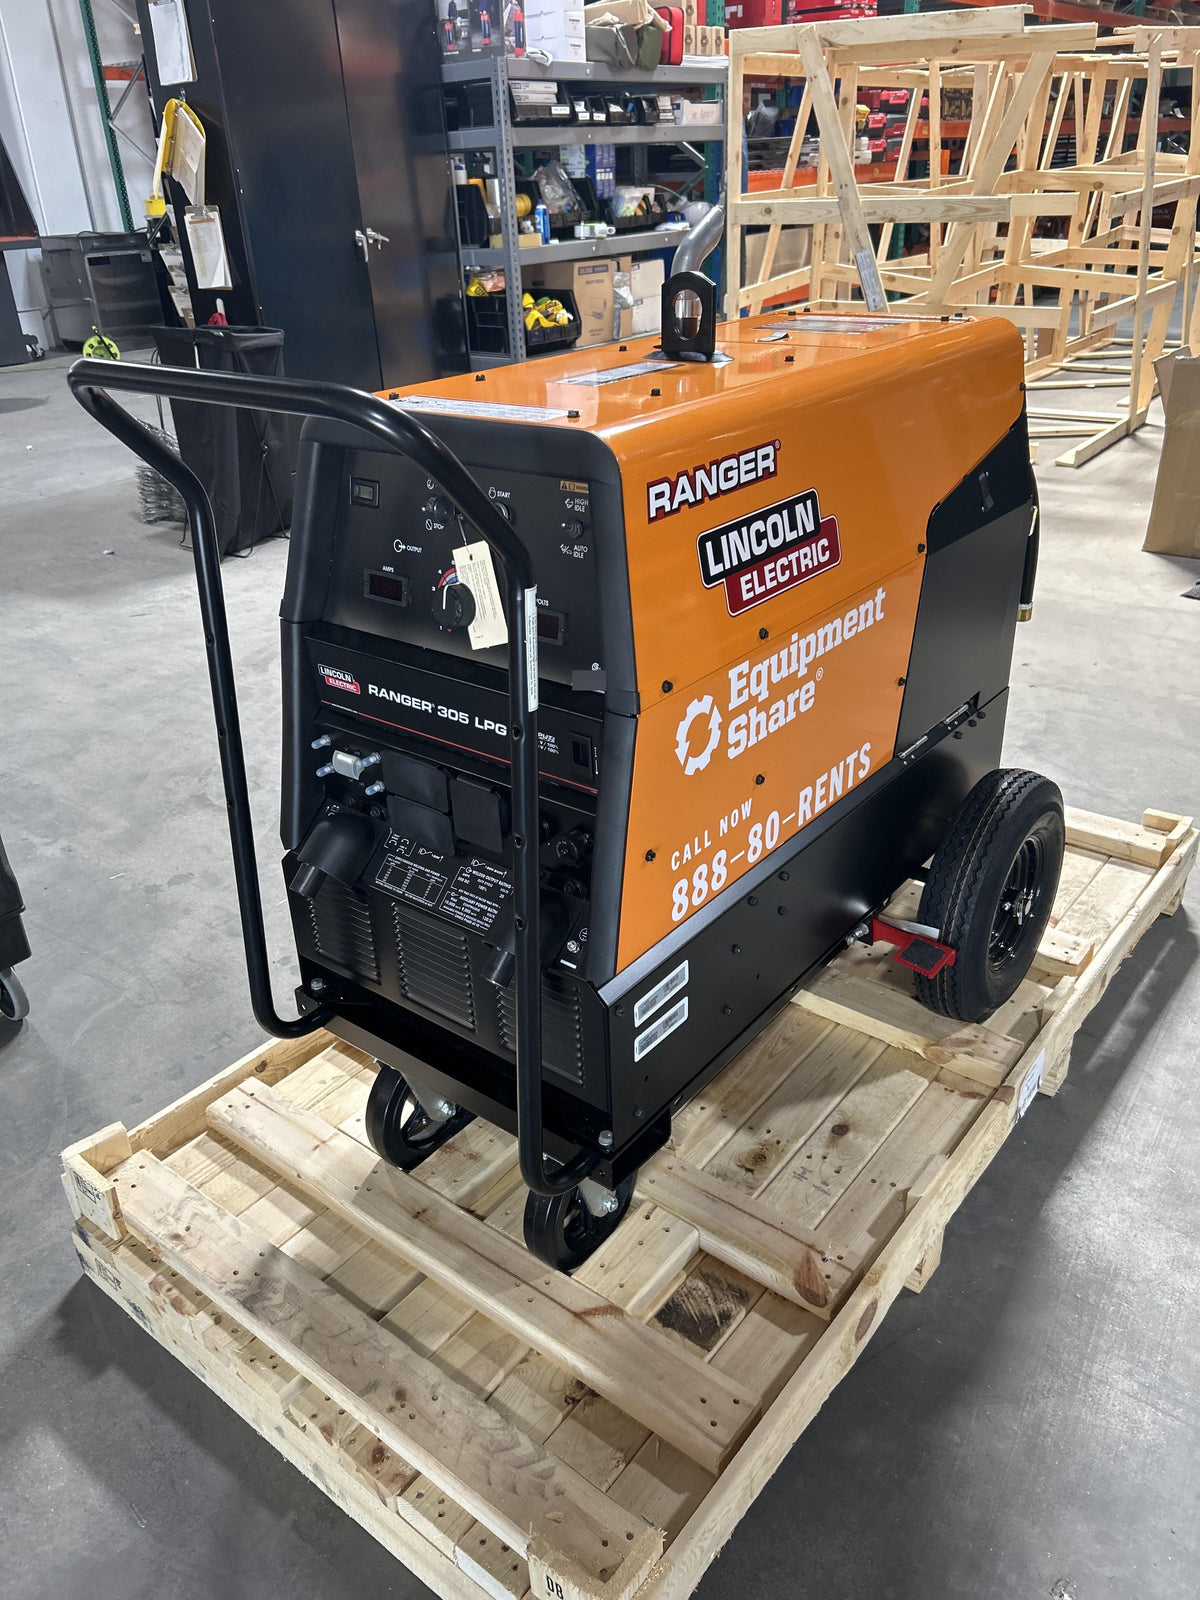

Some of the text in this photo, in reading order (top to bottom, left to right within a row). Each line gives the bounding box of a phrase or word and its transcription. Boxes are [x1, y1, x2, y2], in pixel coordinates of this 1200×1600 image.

[648, 444, 775, 519] RANGER
[496, 491, 511, 499] START
[574, 497, 588, 506] HIGH
[574, 505, 586, 513] IDLE
[705, 499, 815, 577] LINCOLN
[406, 544, 423, 554] OUTPUT
[573, 544, 588, 553] AUTO
[573, 551, 584, 560] IDLE
[382, 565, 395, 573] AMPS
[739, 537, 830, 601] ELECTRIC
[728, 586, 886, 712] Equipment
[320, 666, 352, 683] LINCOLN
[328, 678, 357, 692] ELECTRIC
[368, 684, 508, 737] RANGER 305 LPG
[727, 680, 816, 760] Share
[671, 742, 872, 922] 888-80-RENTS
[671, 797, 753, 871] CALL NOW
